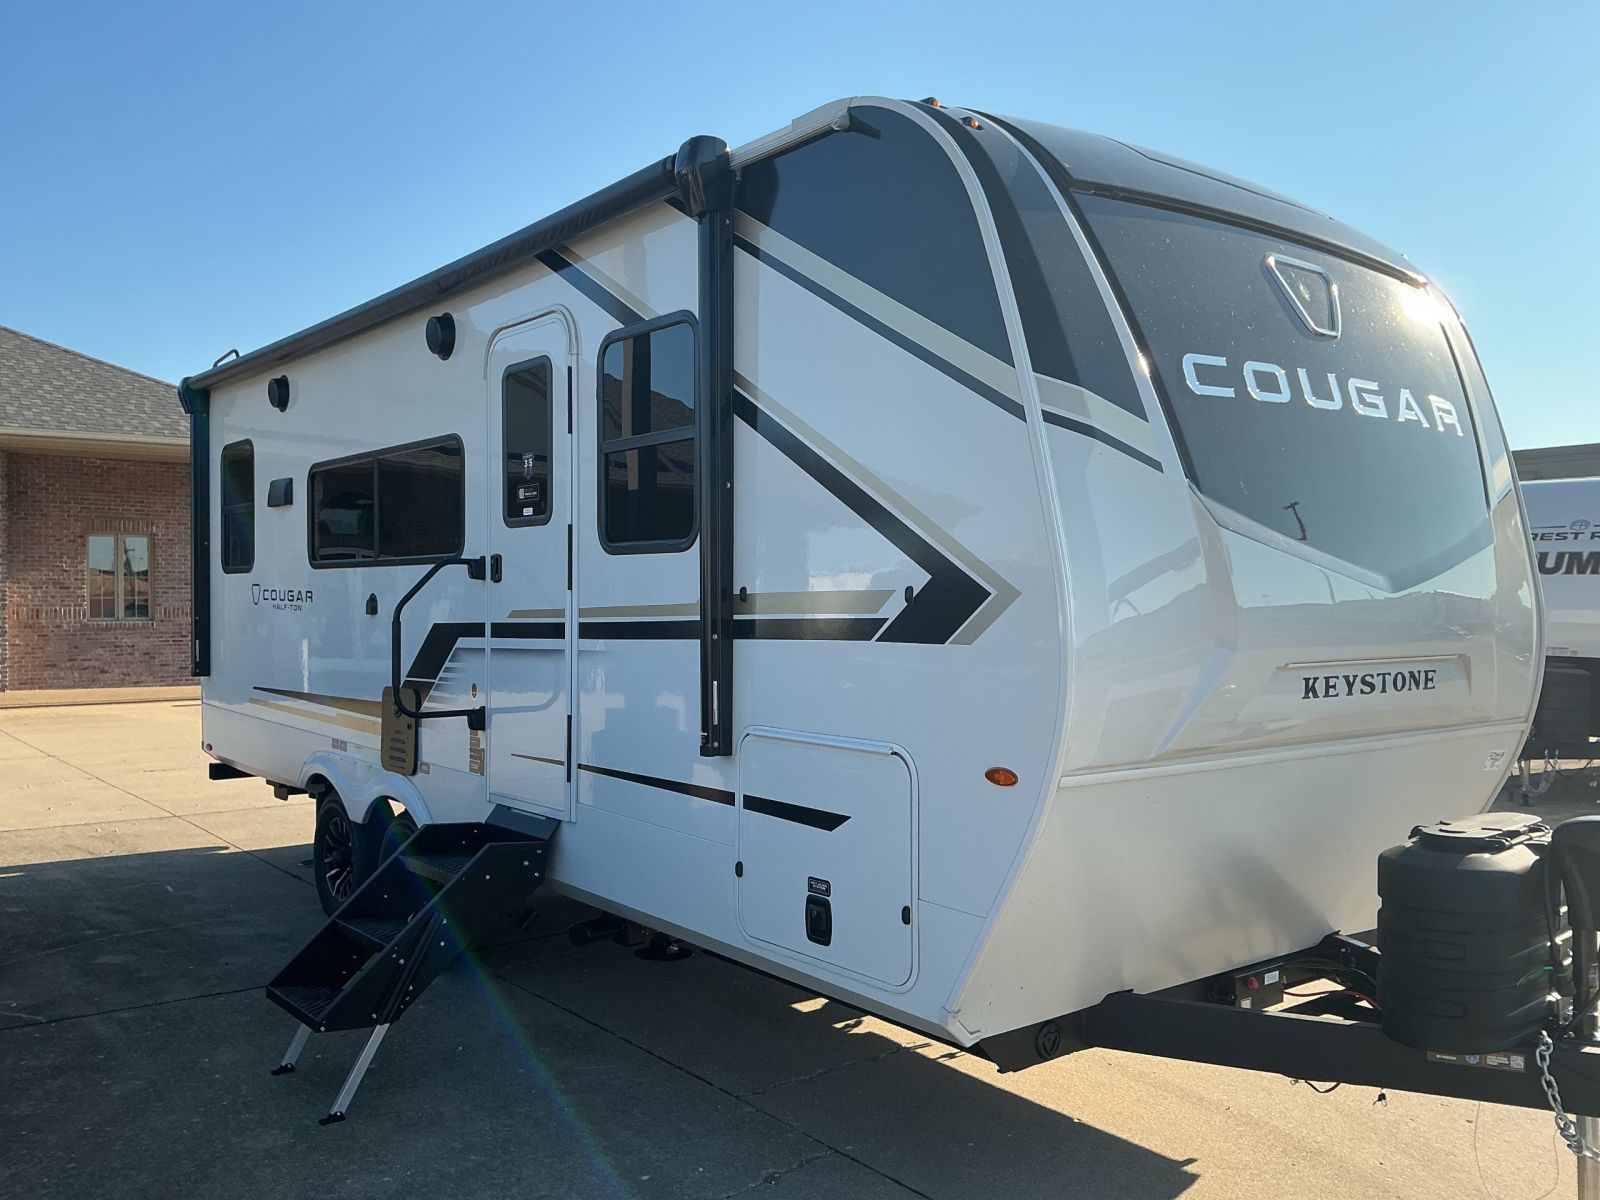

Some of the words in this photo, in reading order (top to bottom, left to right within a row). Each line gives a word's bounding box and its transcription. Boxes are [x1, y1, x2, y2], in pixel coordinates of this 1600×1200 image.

[1182, 353, 1464, 437] COUGAR
[1536, 551, 1600, 576] UM
[263, 589, 314, 603] COUGAR
[273, 603, 303, 612] HALF-TON
[1302, 669, 1437, 700] KEYSTONE
